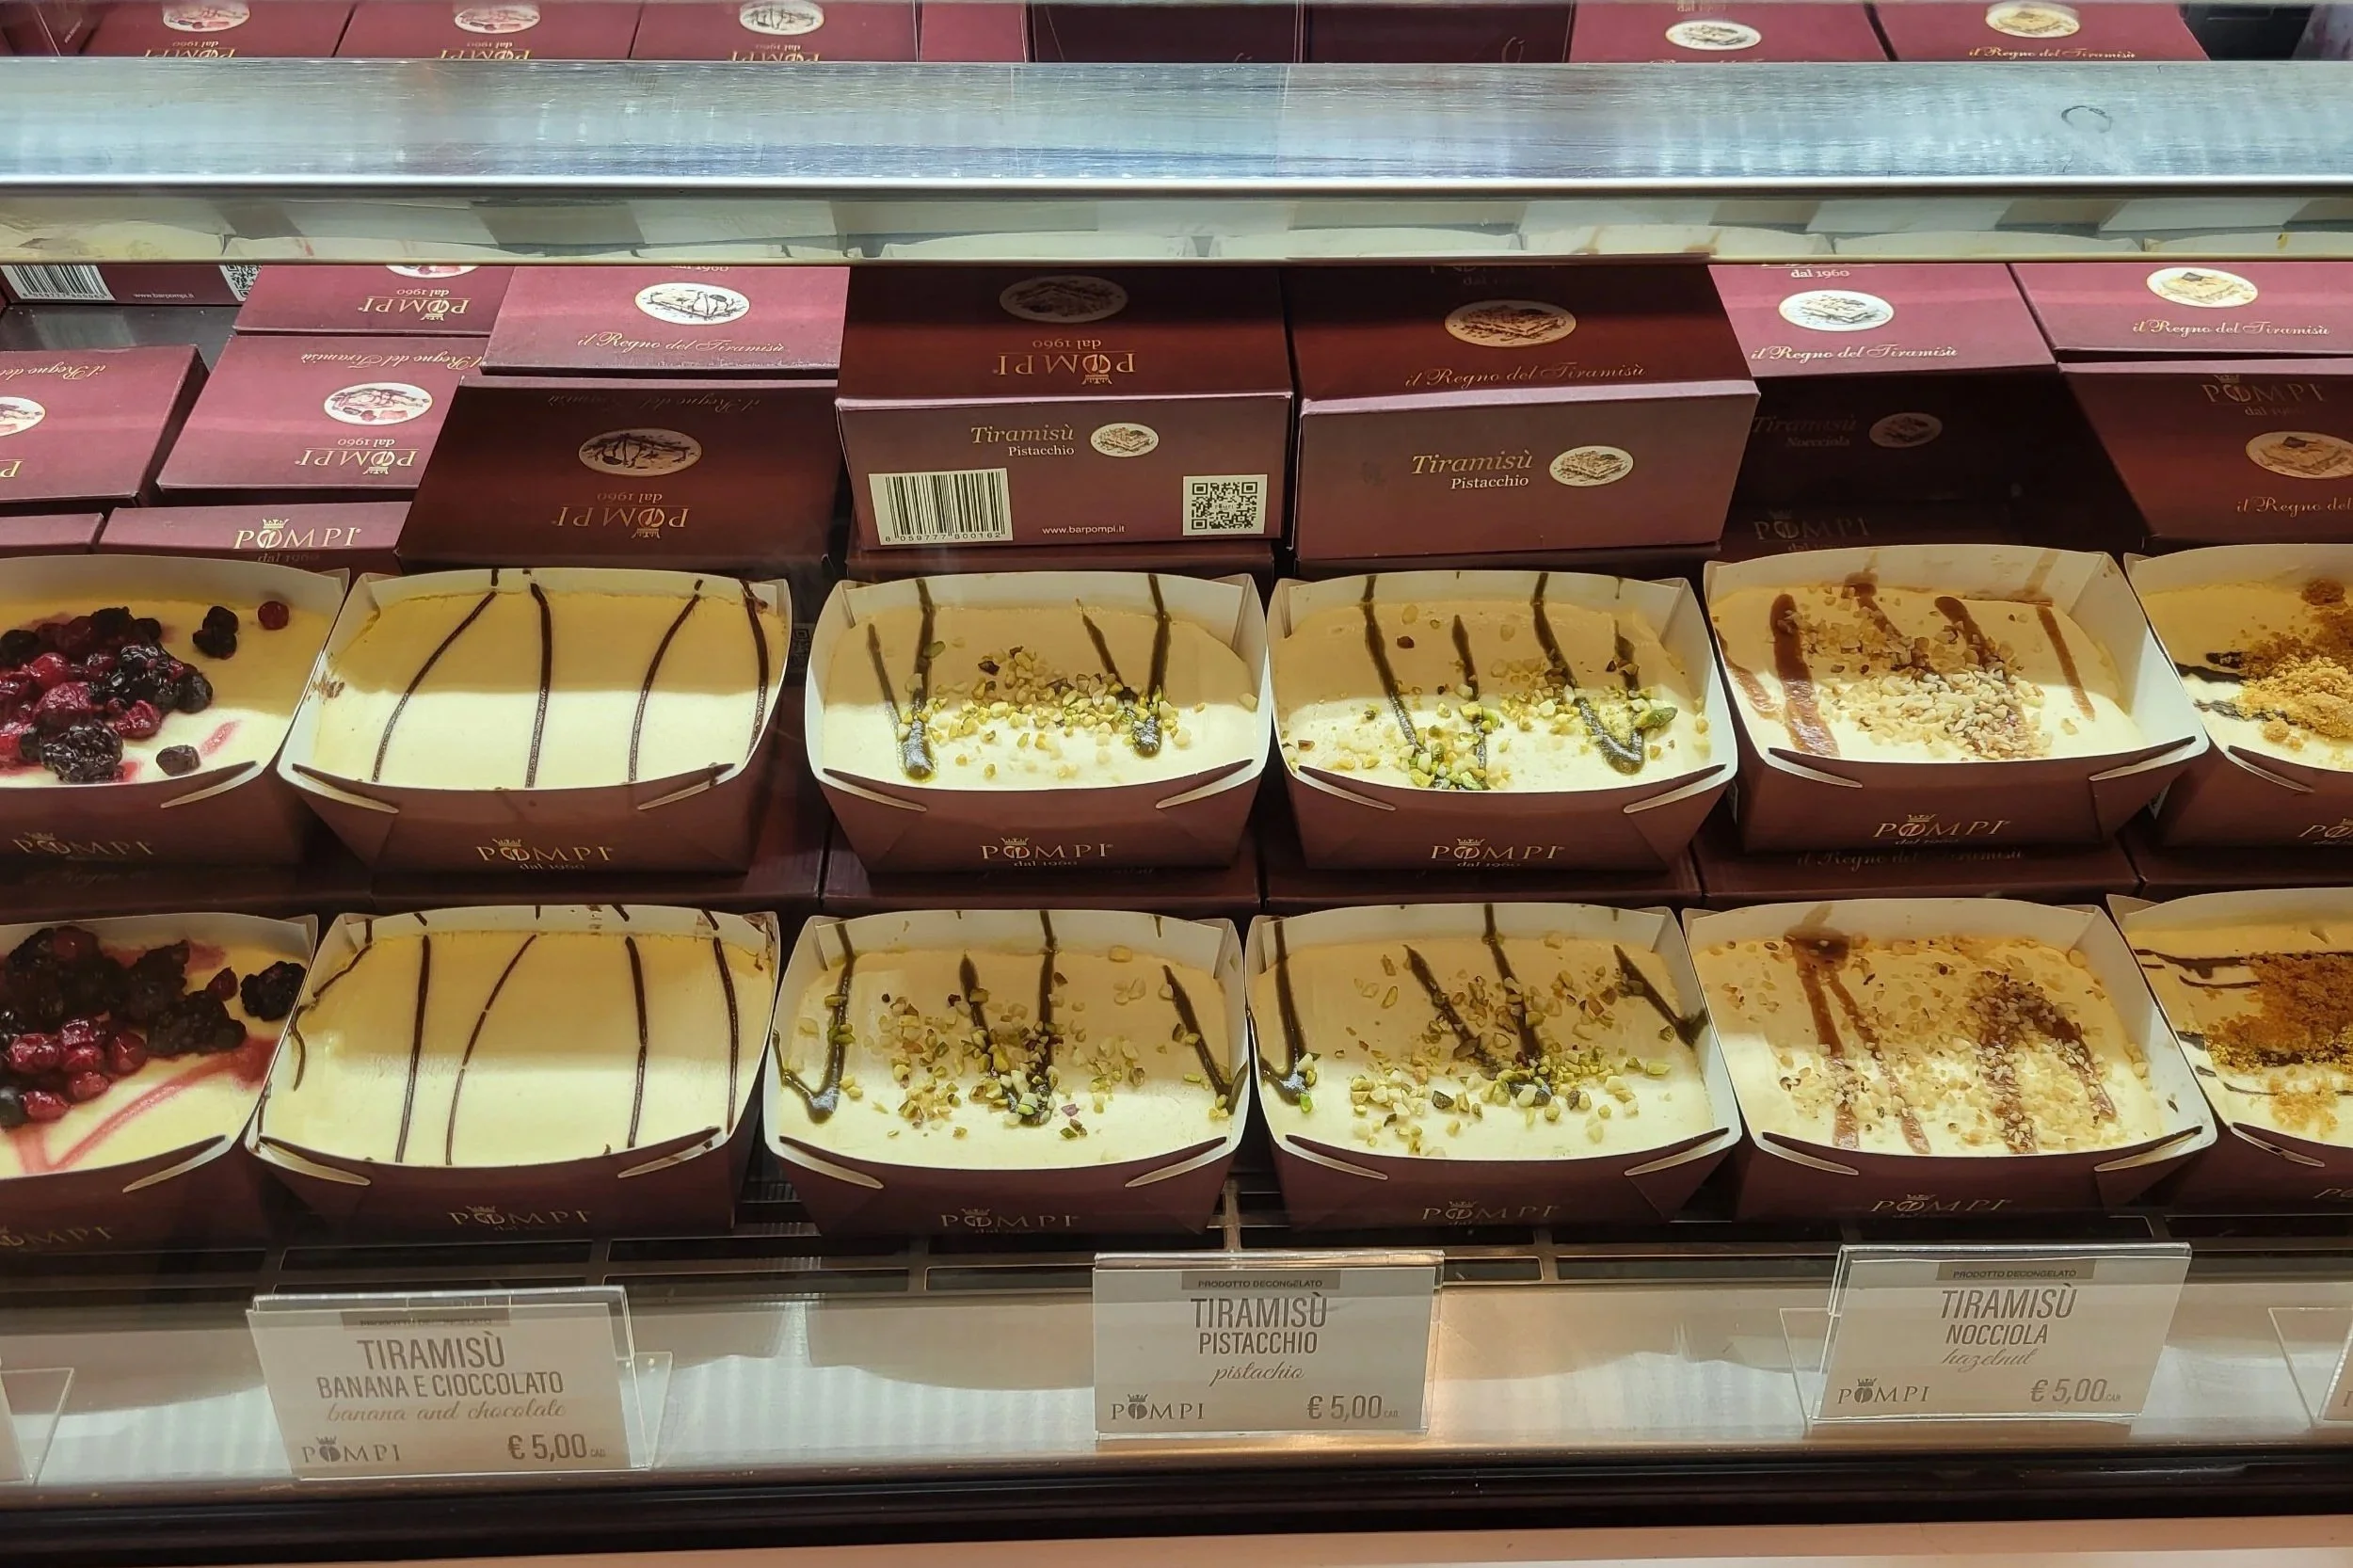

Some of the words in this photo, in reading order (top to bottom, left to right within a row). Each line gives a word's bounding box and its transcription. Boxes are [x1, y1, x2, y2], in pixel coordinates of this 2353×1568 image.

[1790, 268, 1814, 279] dal
[1816, 269, 1852, 280] 1960
[396, 288, 427, 296] 1960
[428, 288, 450, 297] dal
[361, 297, 471, 314] POMPI
[2133, 322, 2146, 333] il
[2146, 319, 2213, 338] Regno
[2216, 321, 2241, 334] del
[2242, 321, 2330, 335] Tiramisù
[577, 333, 597, 347] il
[597, 331, 662, 353] Regno
[665, 339, 696, 352] del
[696, 339, 785, 353] Tiramisù
[1032, 338, 1072, 350] 1960
[1077, 338, 1102, 351] dal
[301, 352, 383, 370] Tiramisù
[380, 355, 412, 368] del
[414, 350, 469, 371] Regno
[469, 354, 483, 368] l
[1751, 346, 1767, 360] il
[1766, 345, 1834, 364] Regno
[1838, 346, 1865, 360] del
[1866, 344, 1959, 359] Tiramisù
[28, 360, 89, 380] Regno
[88, 364, 106, 377] il
[997, 352, 1138, 376] POMPI
[1405, 372, 1423, 388] il
[1426, 368, 1500, 391] Regno
[1506, 365, 1538, 382] del
[1540, 361, 1646, 378] Tiramisù
[2200, 382, 2327, 403] POMPI
[338, 438, 372, 447] 1960
[970, 422, 1075, 446] Tiramisù
[374, 439, 395, 449] dal
[1008, 443, 1075, 457] Pistacchio
[299, 449, 419, 467] POMPI
[1412, 448, 1534, 475] Tiramisù
[1450, 474, 1529, 489] Pistacchio
[597, 490, 634, 502] 1960
[639, 490, 663, 503] dal
[2236, 497, 2249, 513] il
[2250, 496, 2321, 519] Regno
[556, 505, 692, 529] POMPI
[233, 526, 357, 550] POMPI
[900, 534, 947, 542] 059777
[1042, 524, 1126, 535] www.barpompi.it
[1872, 820, 2008, 839] POMPI
[11, 839, 154, 856] POMPI
[475, 845, 612, 862] POMPI
[979, 842, 1109, 860] POMPI
[1430, 844, 1561, 860] POMPI
[1422, 1205, 1557, 1221] POMPI
[1868, 1198, 2009, 1213] POMPI
[447, 1209, 589, 1225] POMPI
[941, 1214, 1073, 1228] POMPI
[0, 1225, 113, 1247] OMPI
[1953, 1270, 2005, 1279] PRODOTTO
[2006, 1269, 2077, 1278] DECONGELATO
[1198, 1279, 1251, 1288] PRODOTTO
[1253, 1279, 1323, 1288] DECONGELATO
[1190, 1291, 1328, 1329] TIRAMISÙ
[1940, 1282, 2078, 1320] TIRAMISÙ
[1199, 1331, 1319, 1355] PISTACCHIO
[1945, 1323, 2050, 1346] NOCCIOLA
[356, 1331, 505, 1370] TIRAMISÙ
[1941, 1348, 2039, 1373] hazelnut
[1209, 1361, 1305, 1387] pistachio
[316, 1375, 410, 1400] BANANA
[413, 1375, 426, 1398] E
[431, 1370, 564, 1398] CIOCCOLATO
[2030, 1379, 2048, 1402] €
[2052, 1378, 2107, 1405] 5,00
[1837, 1385, 1930, 1404] POMPI
[327, 1402, 407, 1422] banana
[417, 1401, 459, 1420] and
[468, 1400, 567, 1420] chocolate
[1111, 1402, 1205, 1420] POMPI
[1306, 1395, 1323, 1420] €
[1331, 1395, 1383, 1423] 5,00
[301, 1443, 401, 1464] POMPI
[508, 1434, 526, 1460] €
[532, 1433, 587, 1463] 5,00
